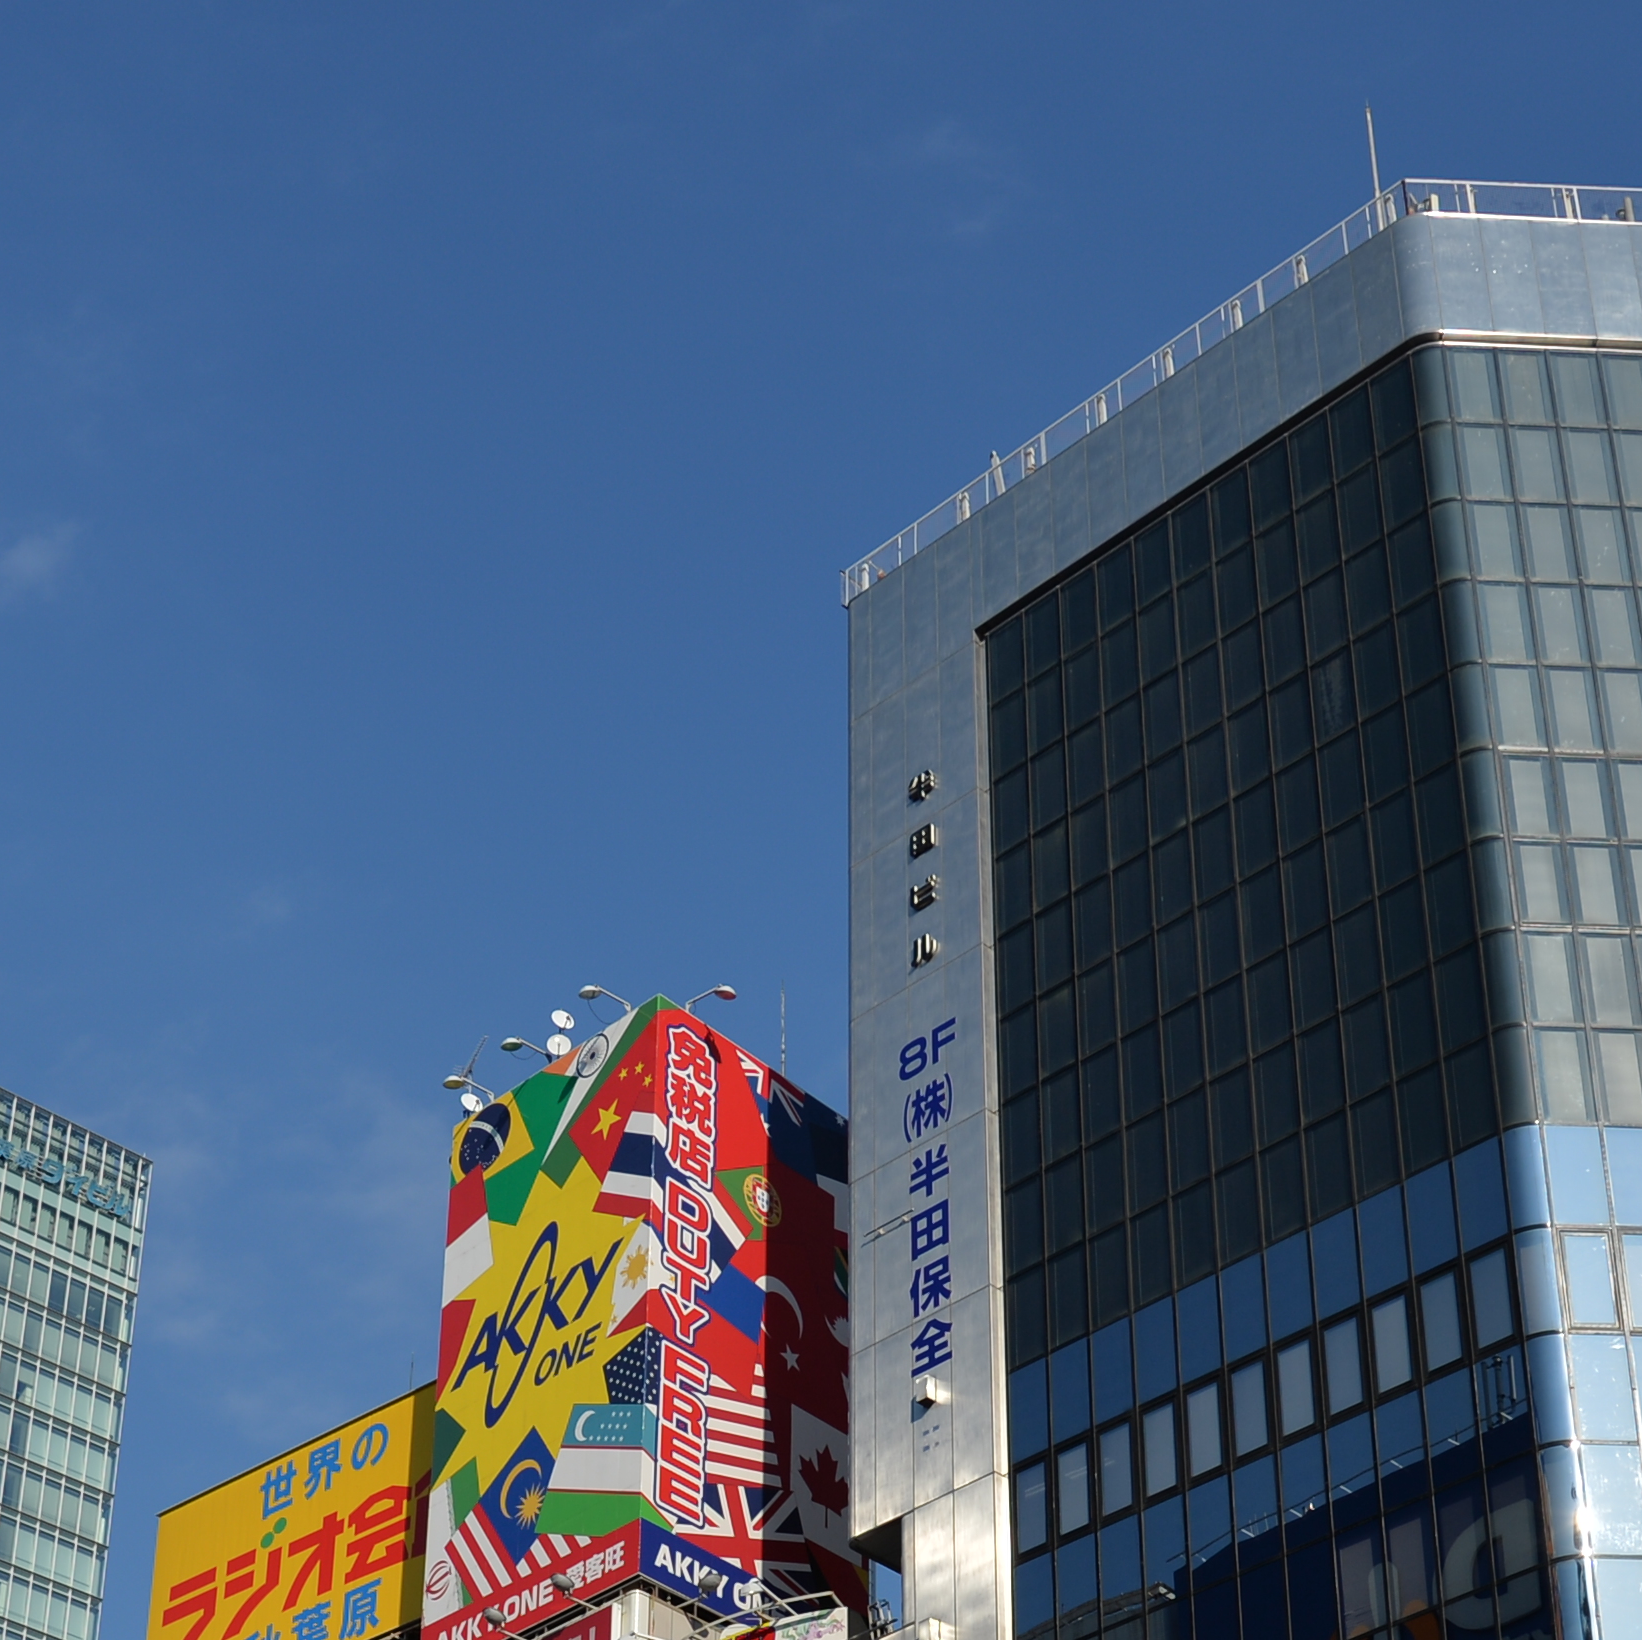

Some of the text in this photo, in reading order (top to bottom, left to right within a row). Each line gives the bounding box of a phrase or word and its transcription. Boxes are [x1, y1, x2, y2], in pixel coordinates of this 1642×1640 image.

[666, 1024, 718, 1190] 免税店
[898, 1016, 957, 1379] 8F (株)半田保全
[535, 1321, 603, 1387] ONE
[656, 1176, 713, 1529] DUTY FREE
[260, 1422, 390, 1520] 世界の
[502, 1579, 556, 1624] ONE
